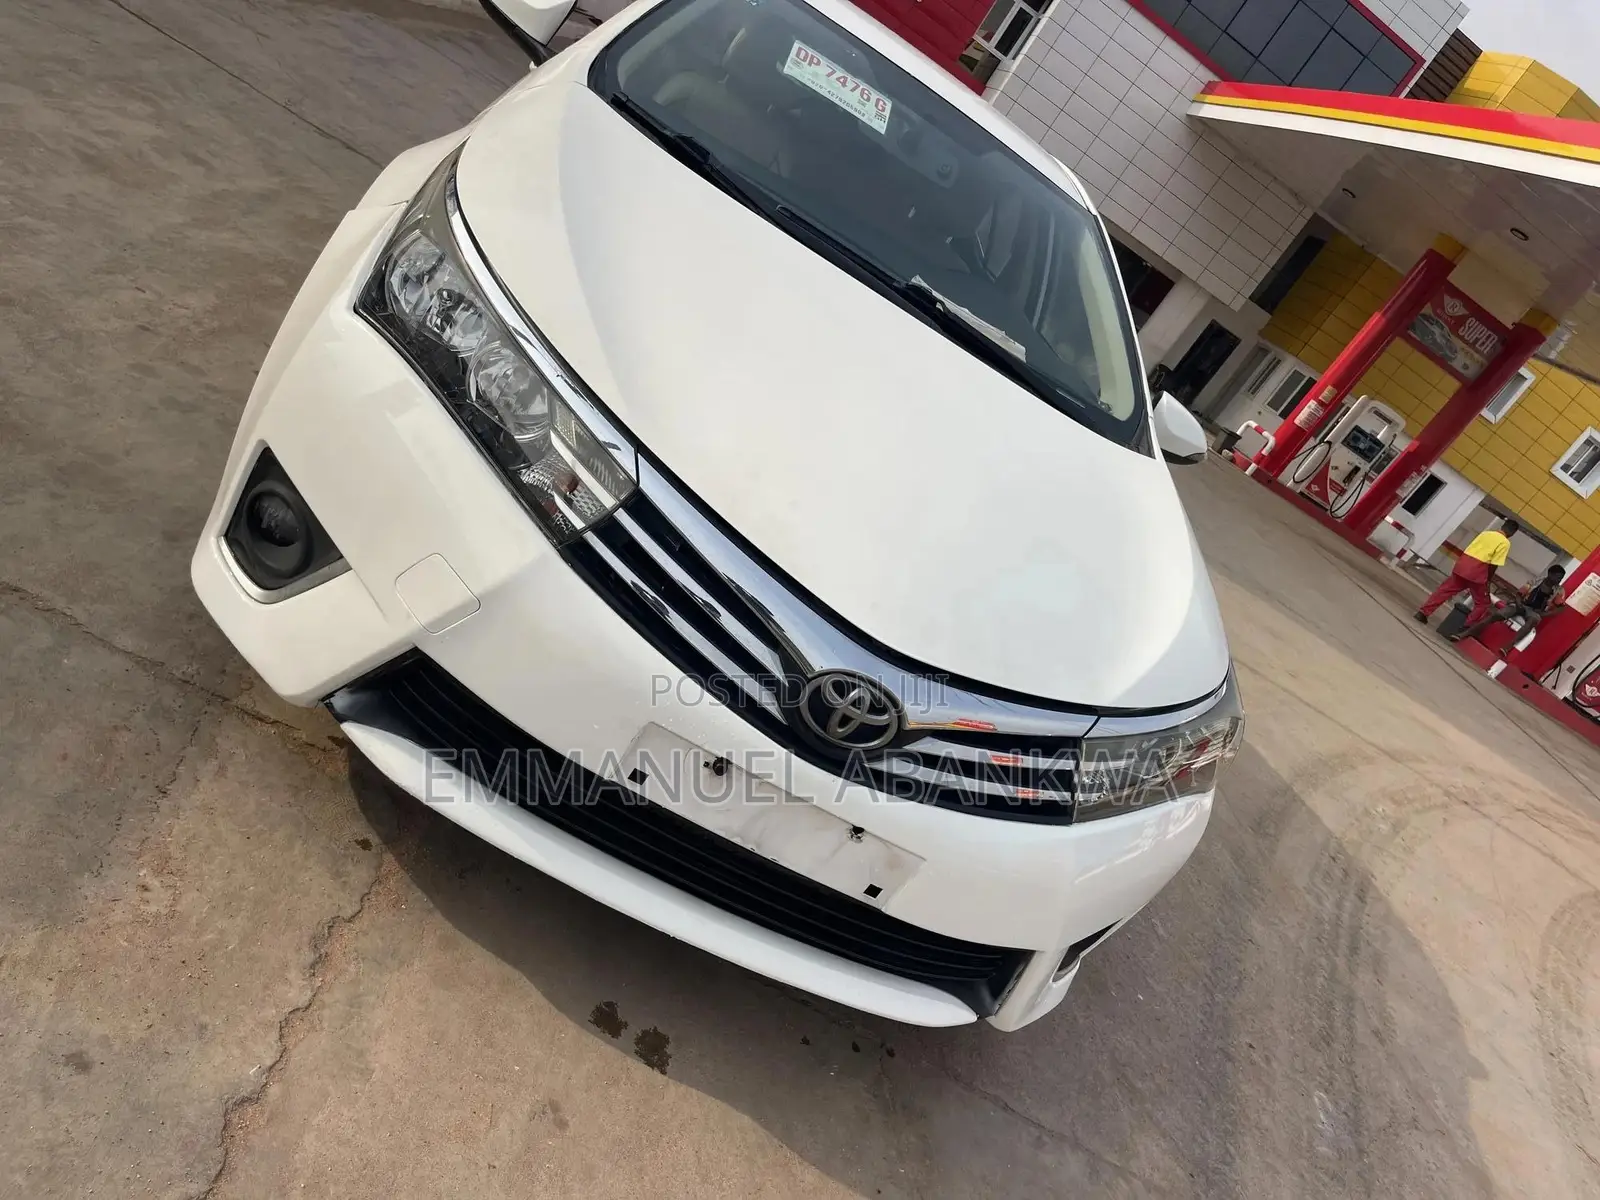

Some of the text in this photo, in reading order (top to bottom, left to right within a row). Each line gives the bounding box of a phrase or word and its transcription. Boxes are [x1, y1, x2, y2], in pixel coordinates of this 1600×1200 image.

[825, 64, 873, 103] 7476
[874, 97, 887, 113] G
[1458, 317, 1498, 355] SUPER
